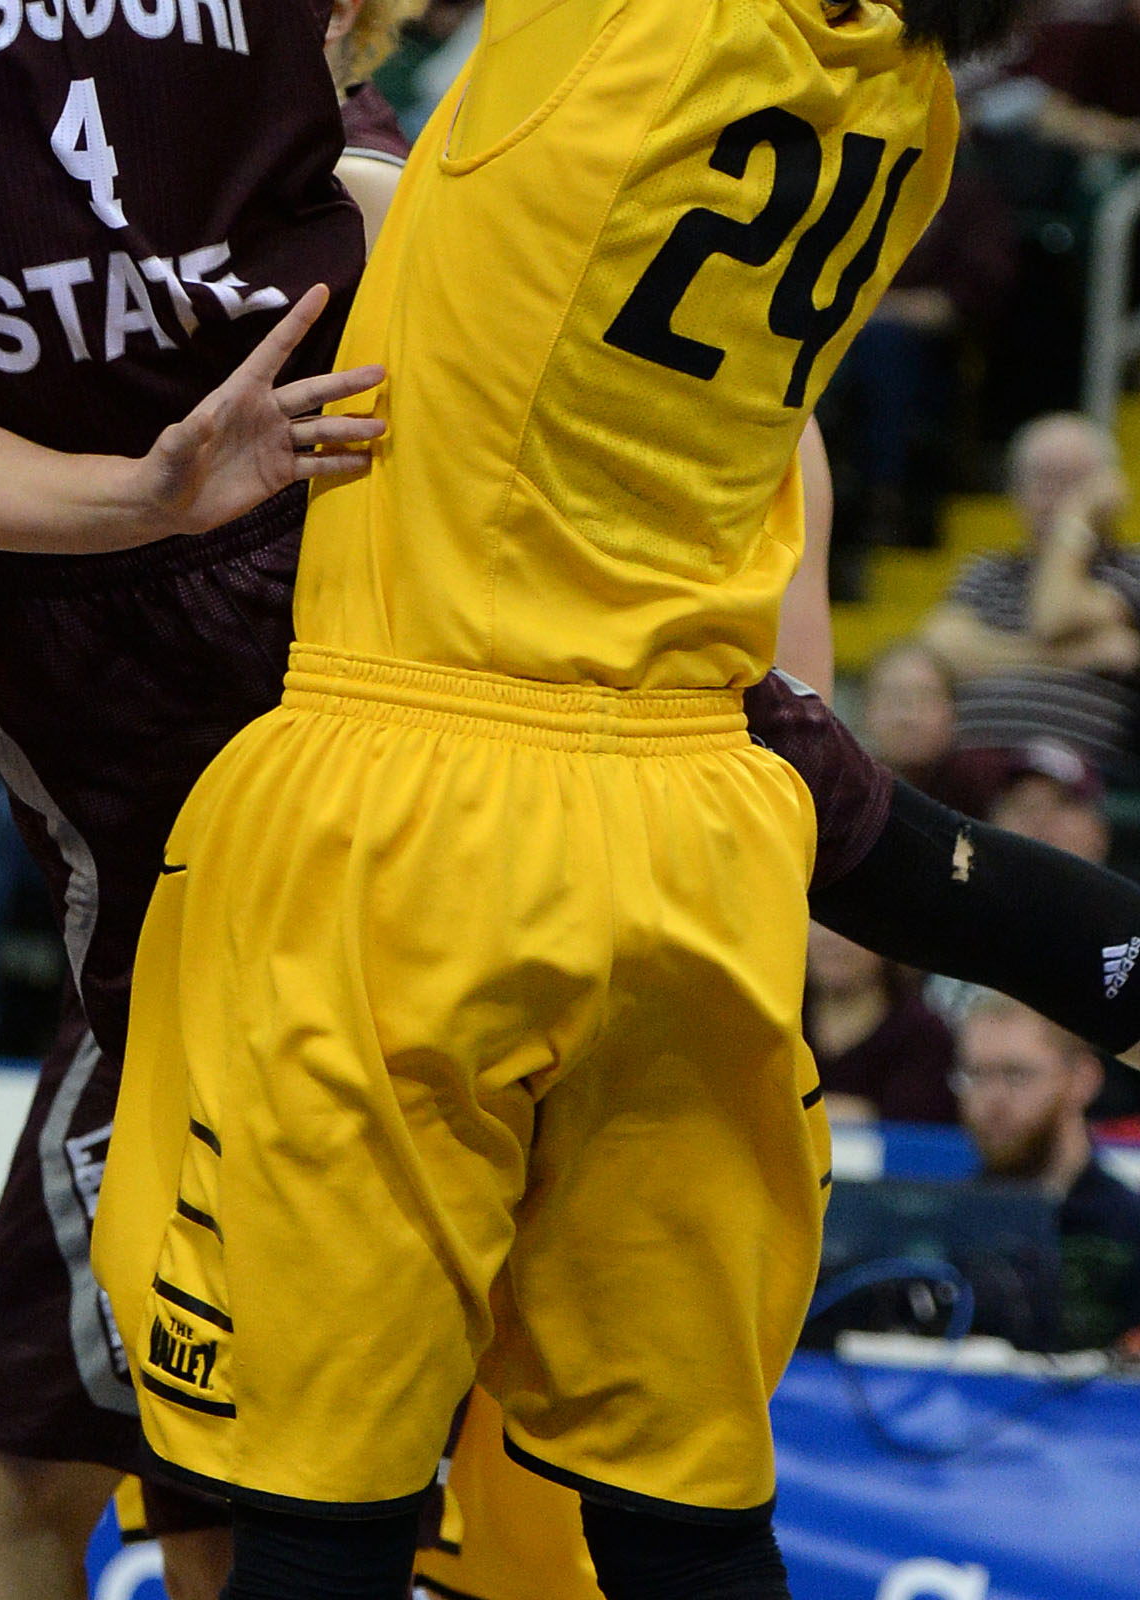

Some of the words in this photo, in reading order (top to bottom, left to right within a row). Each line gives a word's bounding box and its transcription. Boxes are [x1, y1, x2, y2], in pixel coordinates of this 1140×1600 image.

[51, 76, 129, 229] 4
[603, 105, 924, 409] 24
[169, 1316, 194, 1341] THE
